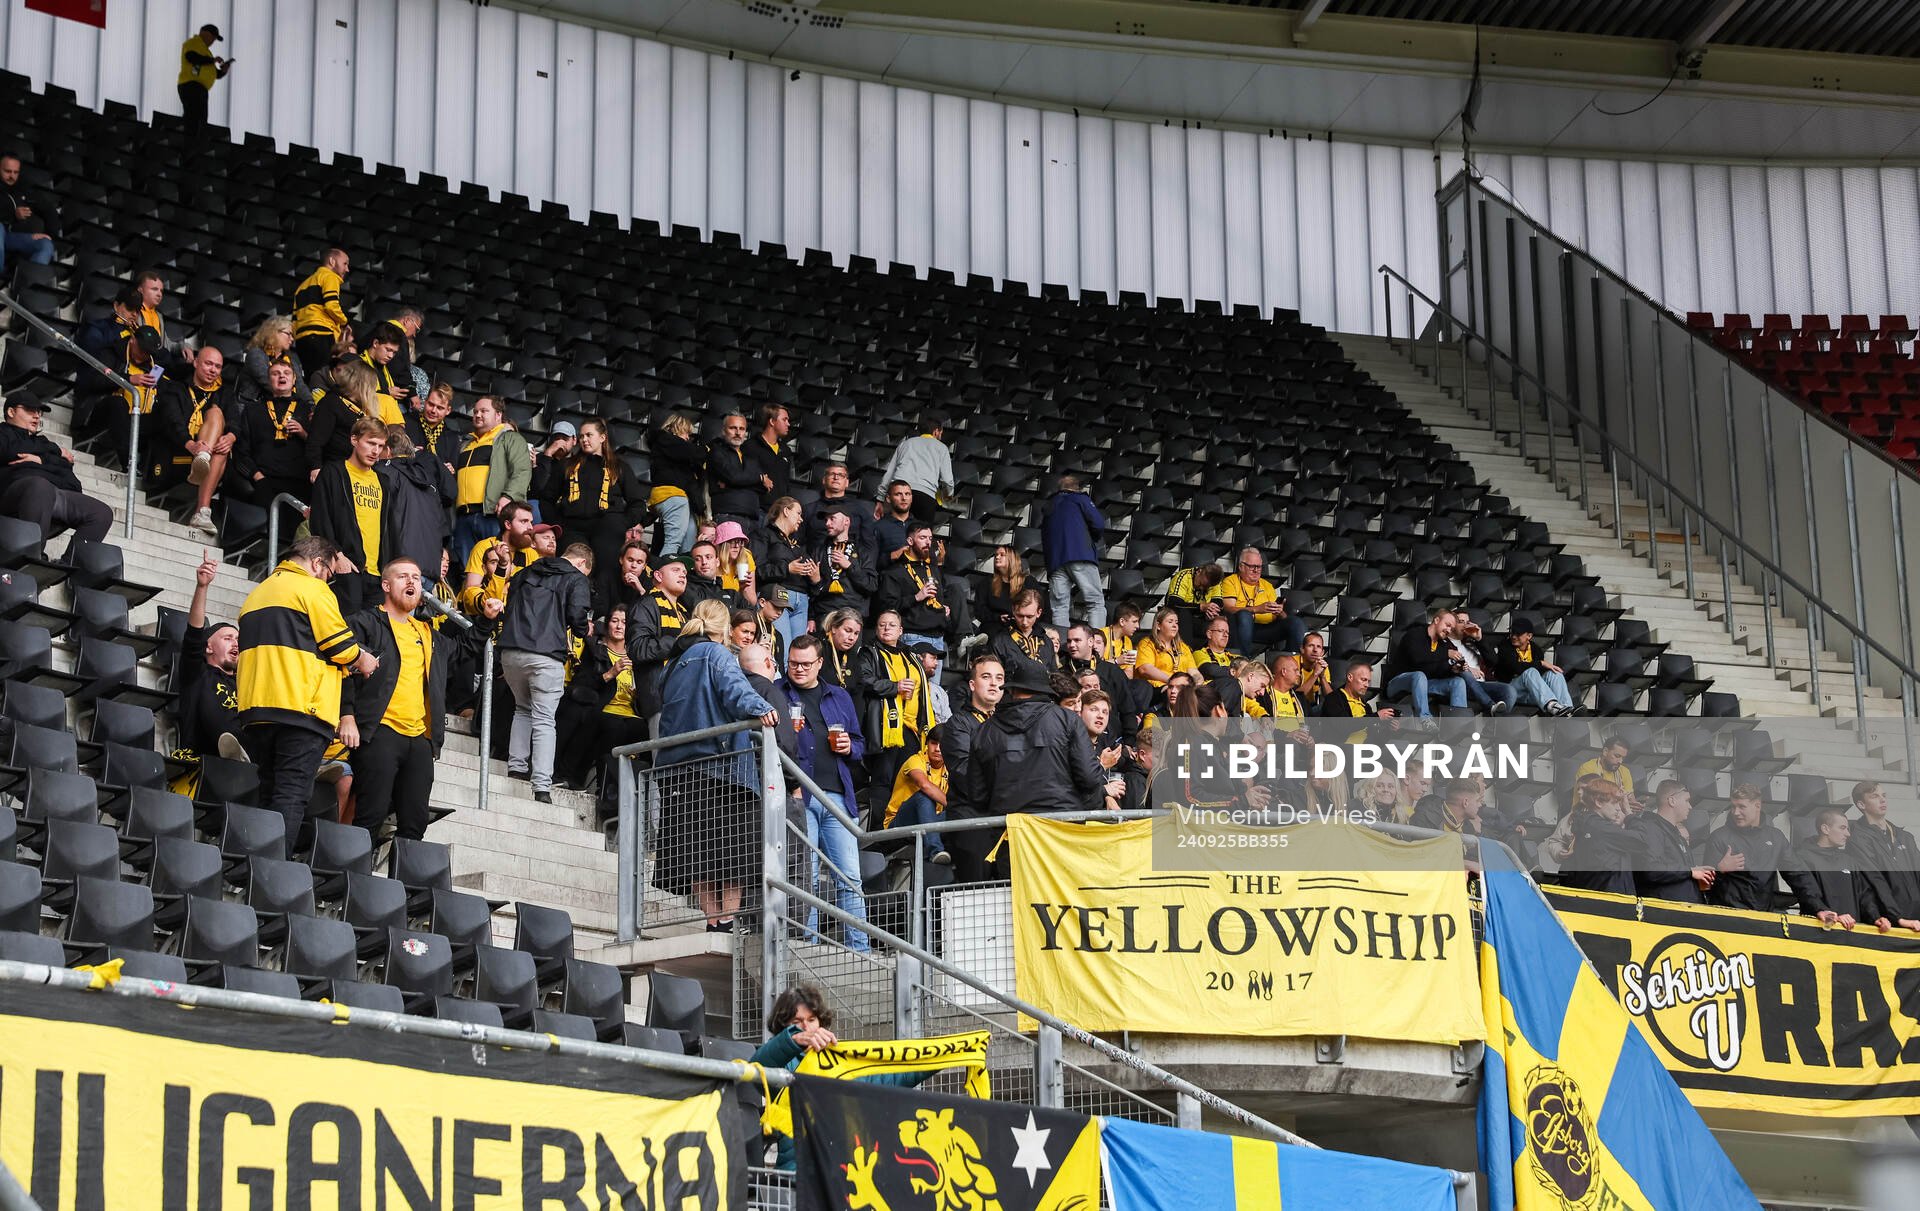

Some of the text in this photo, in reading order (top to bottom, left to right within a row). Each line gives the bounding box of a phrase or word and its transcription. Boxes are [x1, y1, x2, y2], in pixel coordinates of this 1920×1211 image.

[356, 495, 381, 509] Crew
[1226, 874, 1283, 895] THE
[1031, 902, 1457, 961] YELLOWSHIP
[1205, 971, 1314, 992] 20 17
[1622, 948, 1755, 1017] Sektion
[1690, 1000, 1742, 1072] U
